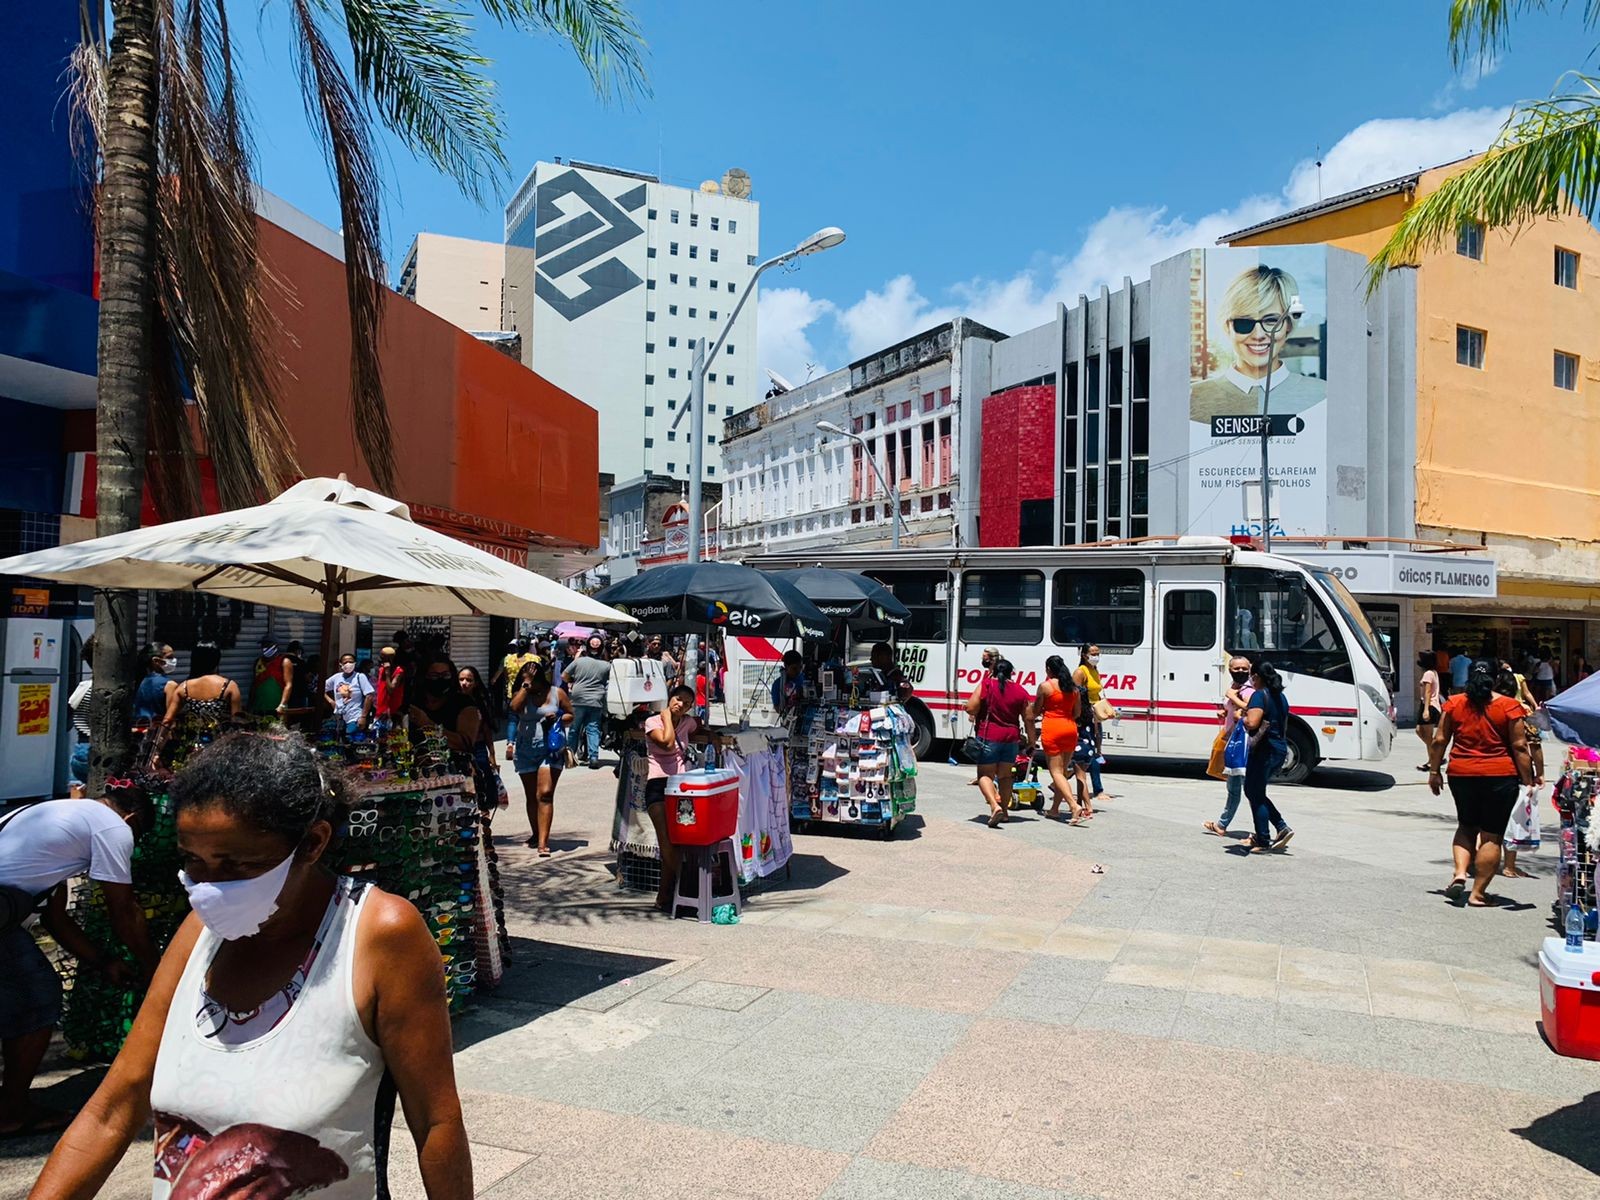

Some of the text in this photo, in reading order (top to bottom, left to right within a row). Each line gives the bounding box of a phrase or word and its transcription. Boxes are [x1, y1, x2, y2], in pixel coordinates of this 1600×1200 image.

[1199, 467, 1256, 476] ESCURECEM
[1269, 466, 1317, 476] CLAREIAM
[1201, 479, 1222, 488] NUM
[1279, 479, 1311, 488] OLHOS
[1434, 571, 1490, 587] FLAMENGO
[631, 604, 669, 617] PagBank
